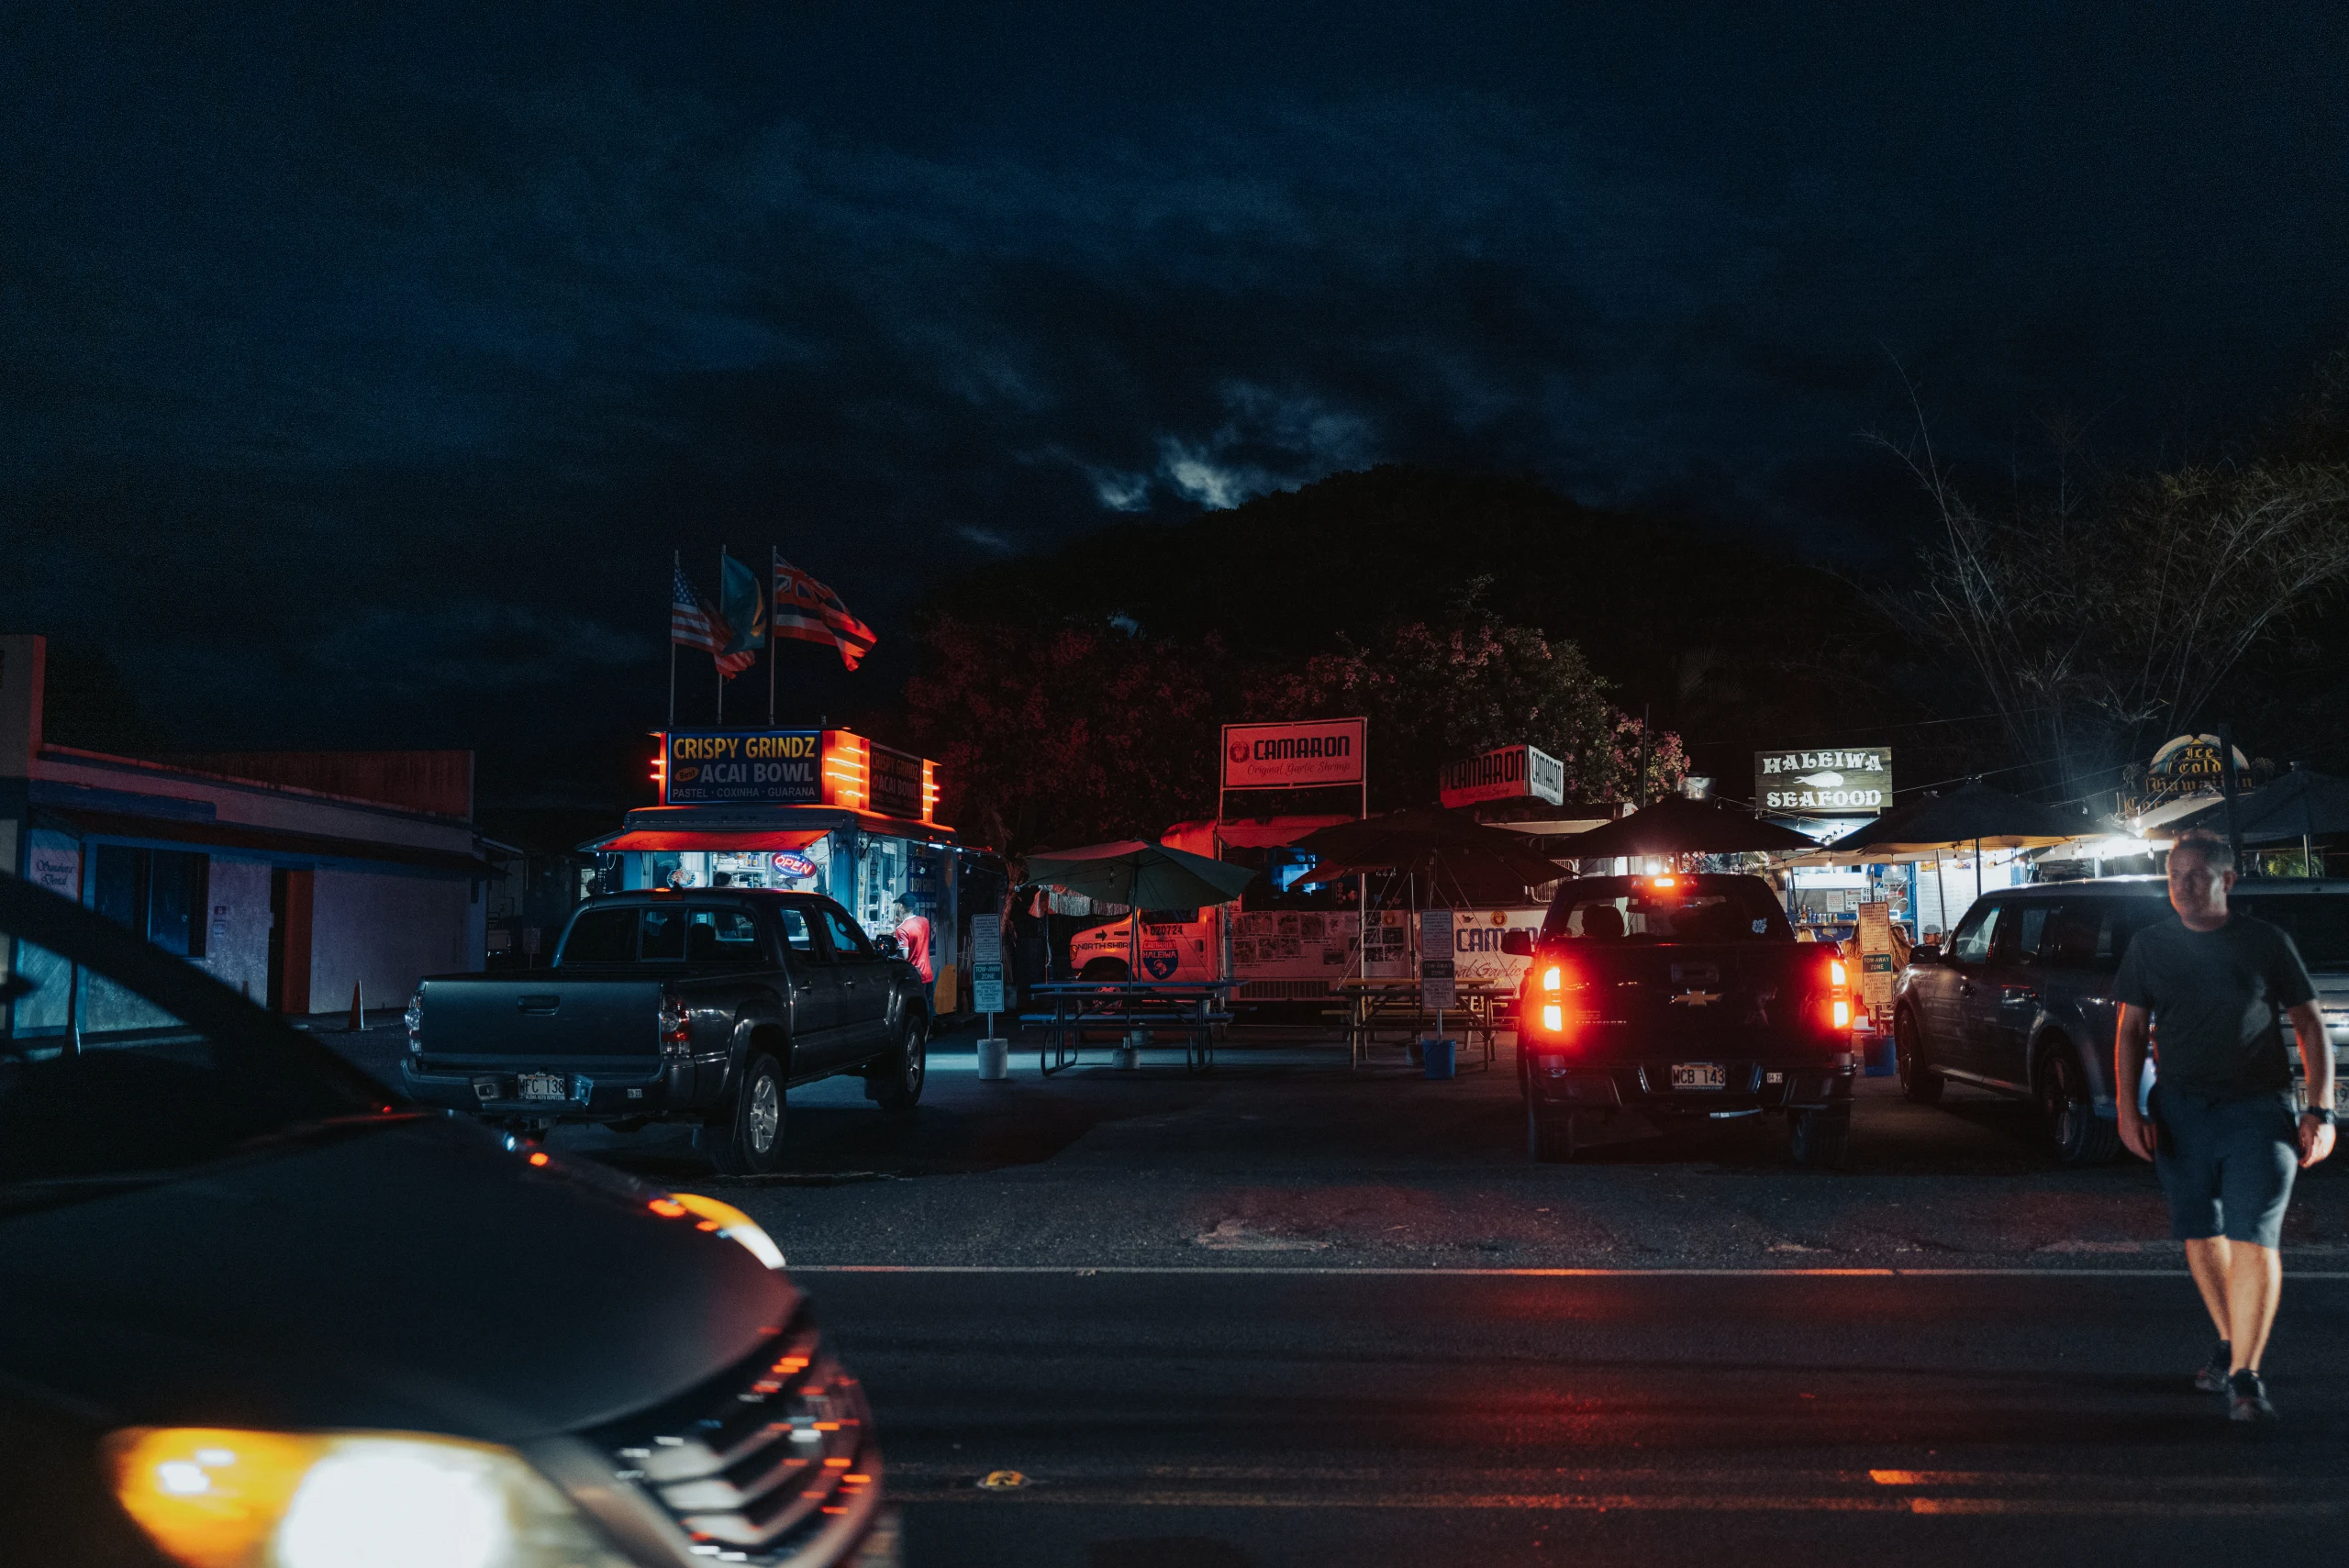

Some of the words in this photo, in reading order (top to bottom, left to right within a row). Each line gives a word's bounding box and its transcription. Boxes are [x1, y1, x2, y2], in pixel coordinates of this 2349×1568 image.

[674, 738, 739, 760] CRISPY
[746, 737, 816, 758] GRINDZ
[1254, 736, 1349, 760] CAMARON
[872, 752, 895, 773] CRISPY
[896, 759, 918, 780] GRINDZ
[1247, 762, 1283, 777] Original
[1286, 762, 1314, 776] Garlic
[1318, 761, 1350, 773] Shrimp
[1452, 750, 1525, 790] CAMARON
[1763, 751, 1883, 774] HALEIWA
[679, 770, 696, 779] Best
[700, 763, 746, 783] ACAI
[754, 763, 813, 782] BOWL
[1532, 751, 1561, 795] CAMARON
[673, 789, 708, 798] PASTEL
[717, 788, 759, 797] COXINHA
[768, 787, 815, 797] GUARANA
[1767, 789, 1881, 807] SEAFOOD
[775, 856, 812, 874] OPEN
[1151, 925, 1183, 935] 020724
[1476, 959, 1522, 979] Garlic
[519, 1080, 538, 1093] WFC
[546, 1080, 564, 1093] 138
[1673, 1069, 1695, 1084] WCB
[1704, 1069, 1724, 1084] 143
